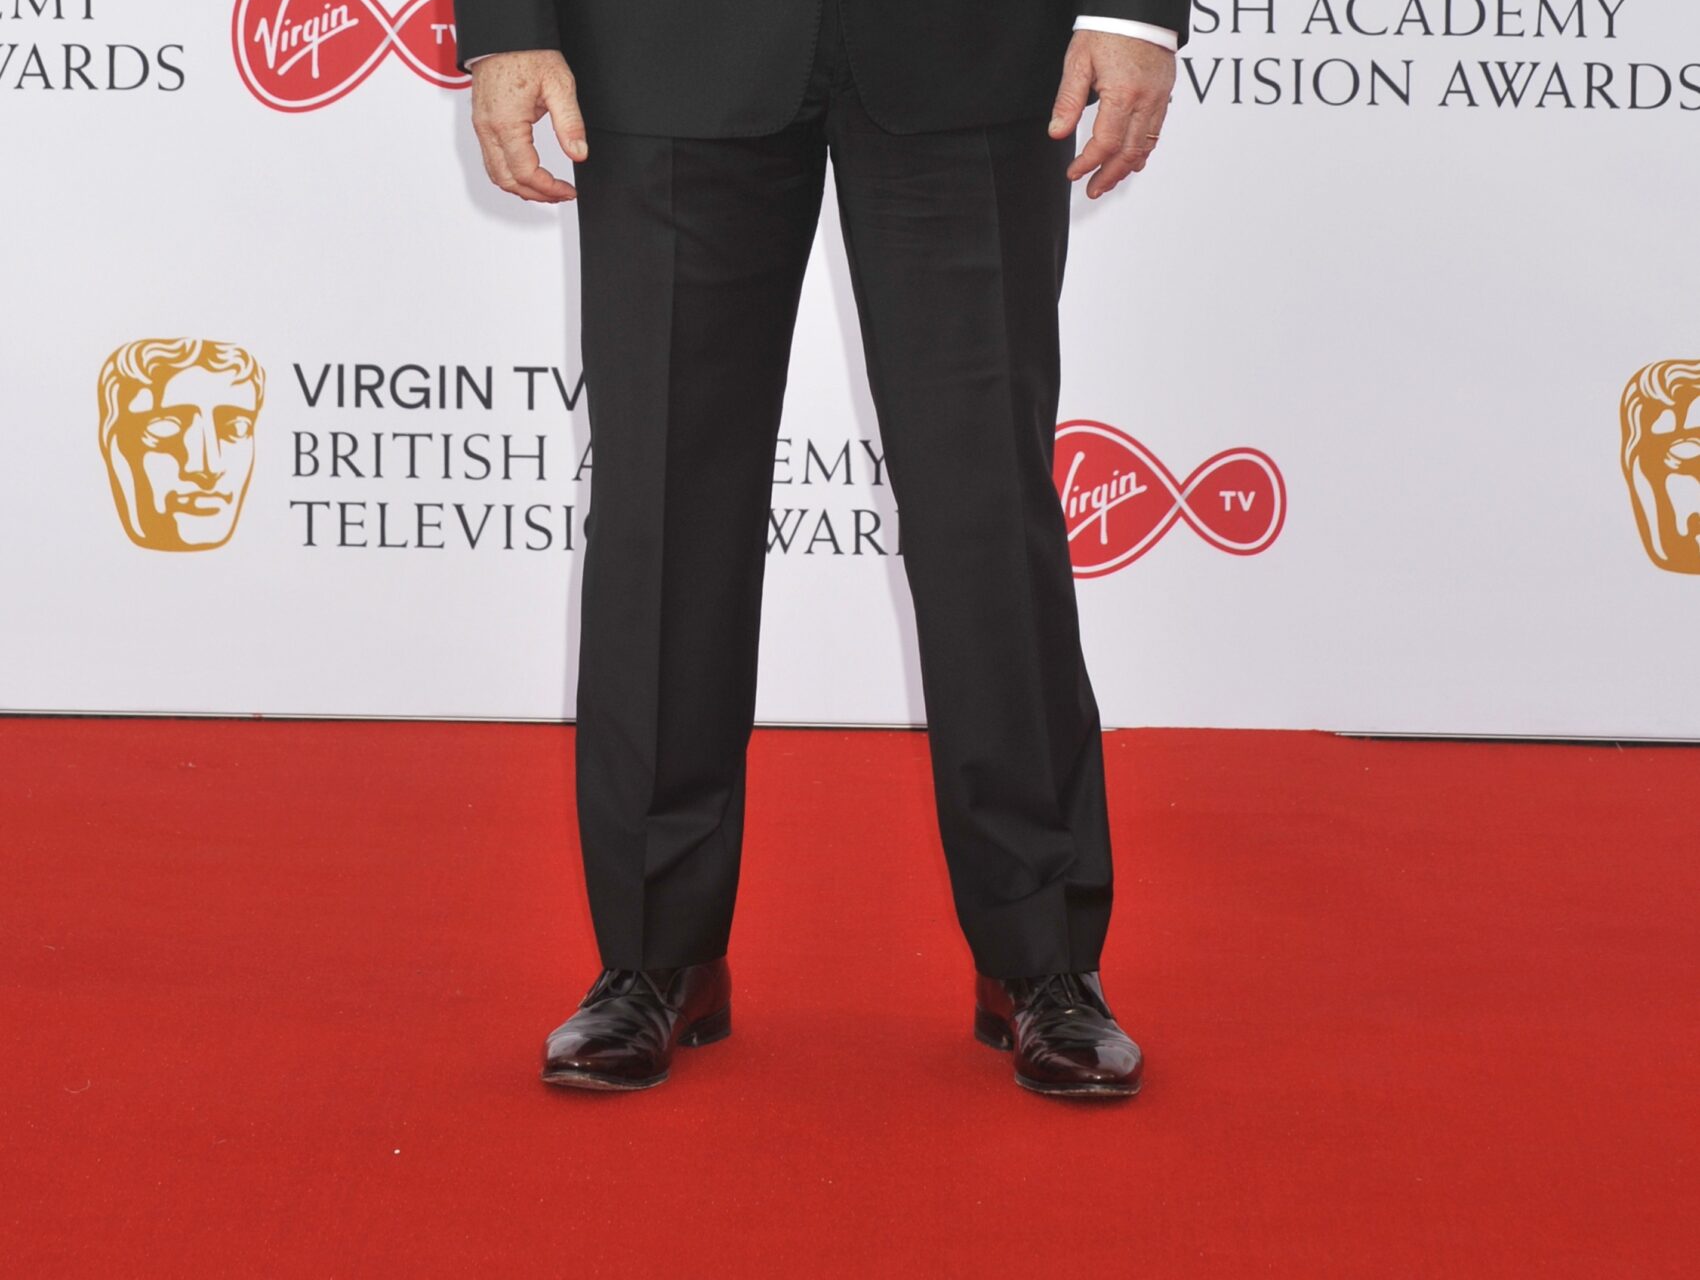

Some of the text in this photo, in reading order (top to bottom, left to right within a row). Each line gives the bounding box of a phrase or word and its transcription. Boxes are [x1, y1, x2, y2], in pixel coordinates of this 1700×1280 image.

[1168, 57, 1700, 111] VISION AWARDS
[292, 363, 586, 411] VIRGIN TV
[293, 431, 546, 481] BRITISH
[289, 500, 590, 551] TELEVISI
[1219, 491, 1255, 512] TV
[766, 508, 903, 556] WAR
